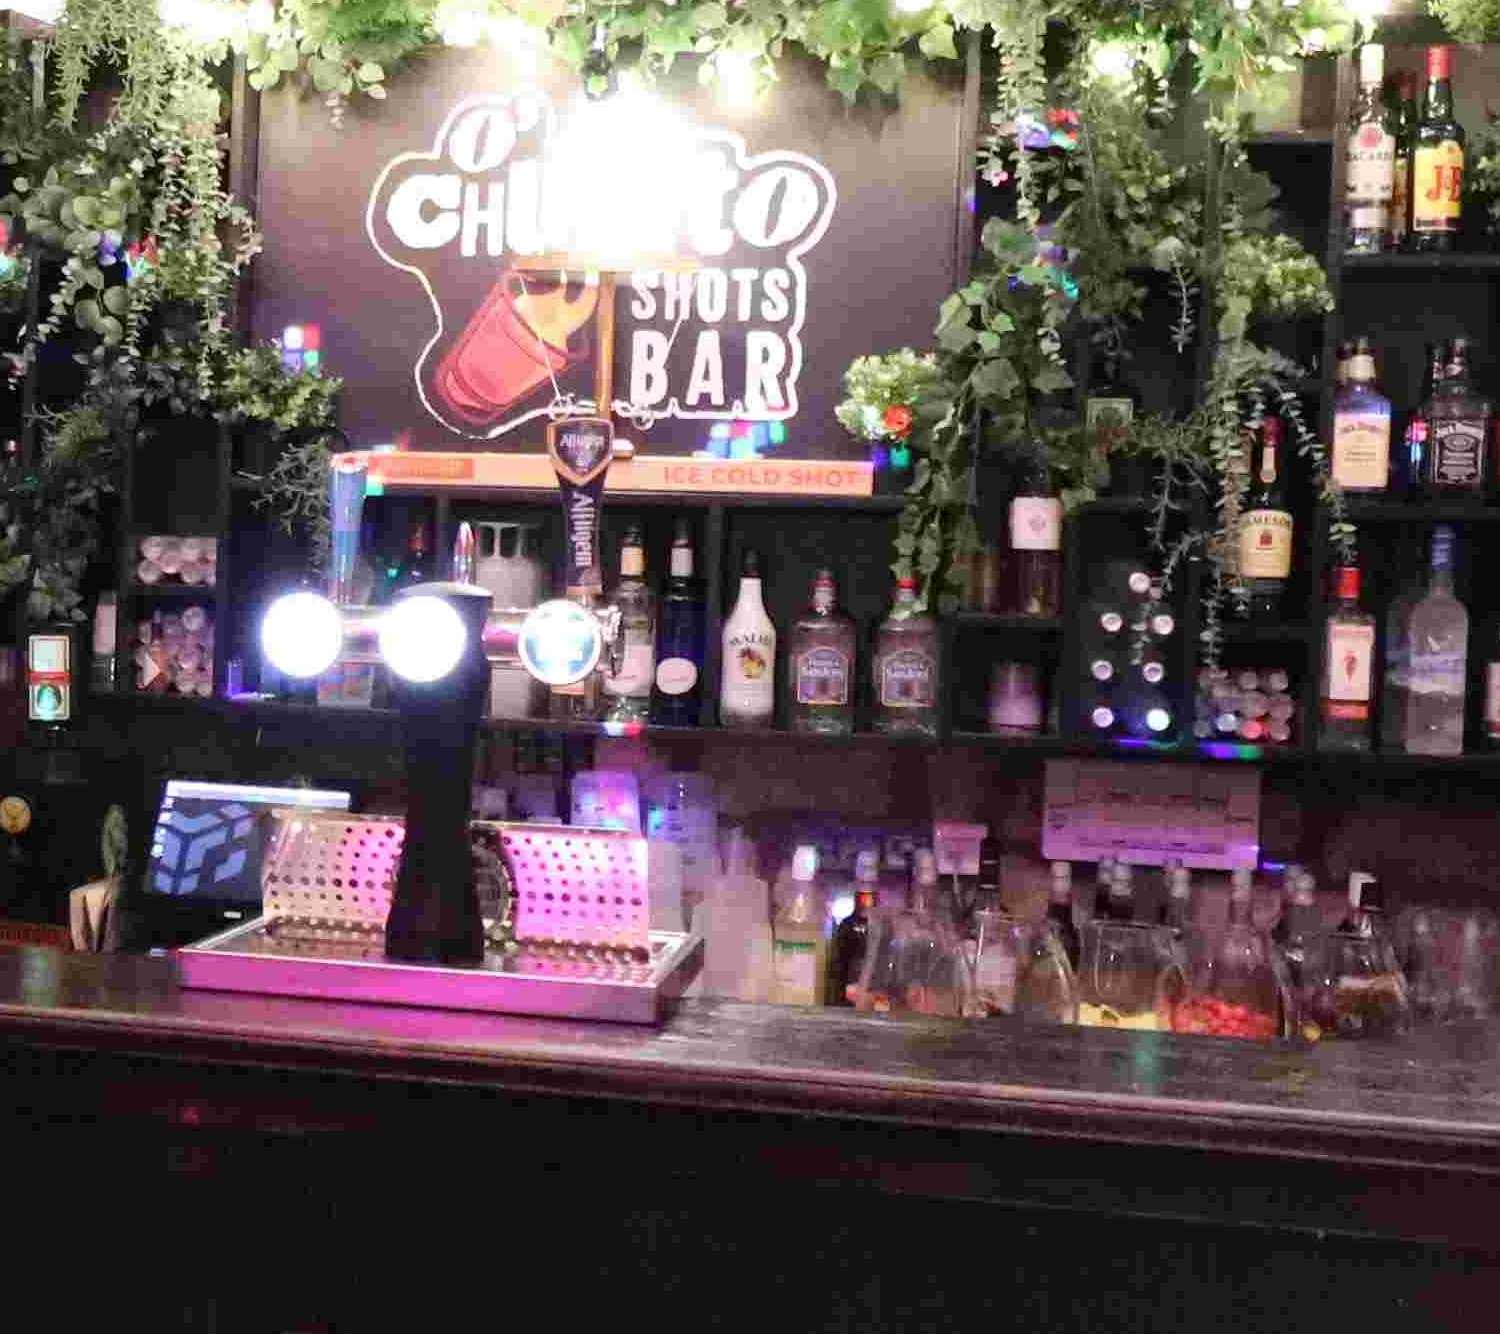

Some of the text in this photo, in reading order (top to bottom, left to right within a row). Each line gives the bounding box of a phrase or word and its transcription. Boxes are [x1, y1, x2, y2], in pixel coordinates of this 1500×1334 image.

[631, 268, 790, 323] SHOTS
[630, 329, 789, 413] BAR
[664, 466, 859, 489] ICE COLD SHOT
